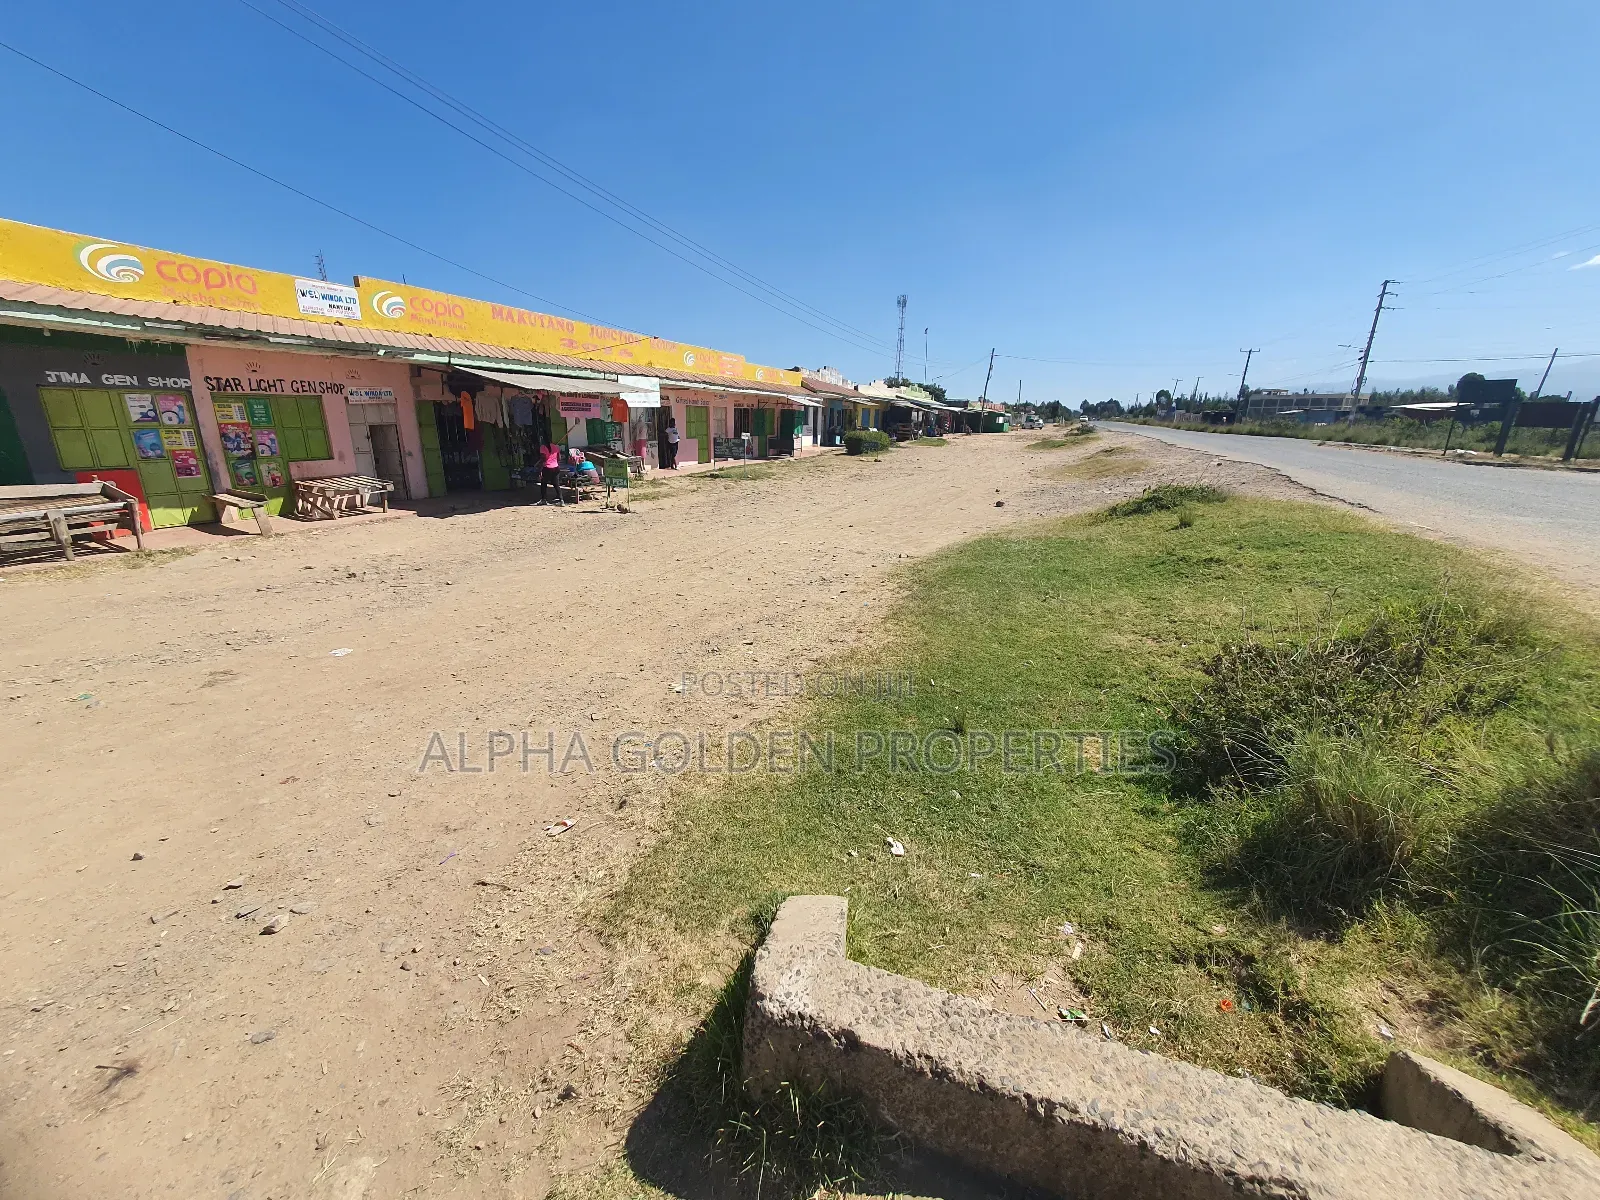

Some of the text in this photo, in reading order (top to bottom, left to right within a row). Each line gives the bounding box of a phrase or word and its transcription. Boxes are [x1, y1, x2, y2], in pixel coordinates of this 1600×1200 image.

[344, 296, 357, 305] LTD
[491, 303, 575, 334] MAKUTANO
[101, 373, 139, 386] GEN
[147, 376, 192, 389] SHOP
[203, 375, 346, 395] STAR LIGHT GEN SHOP
